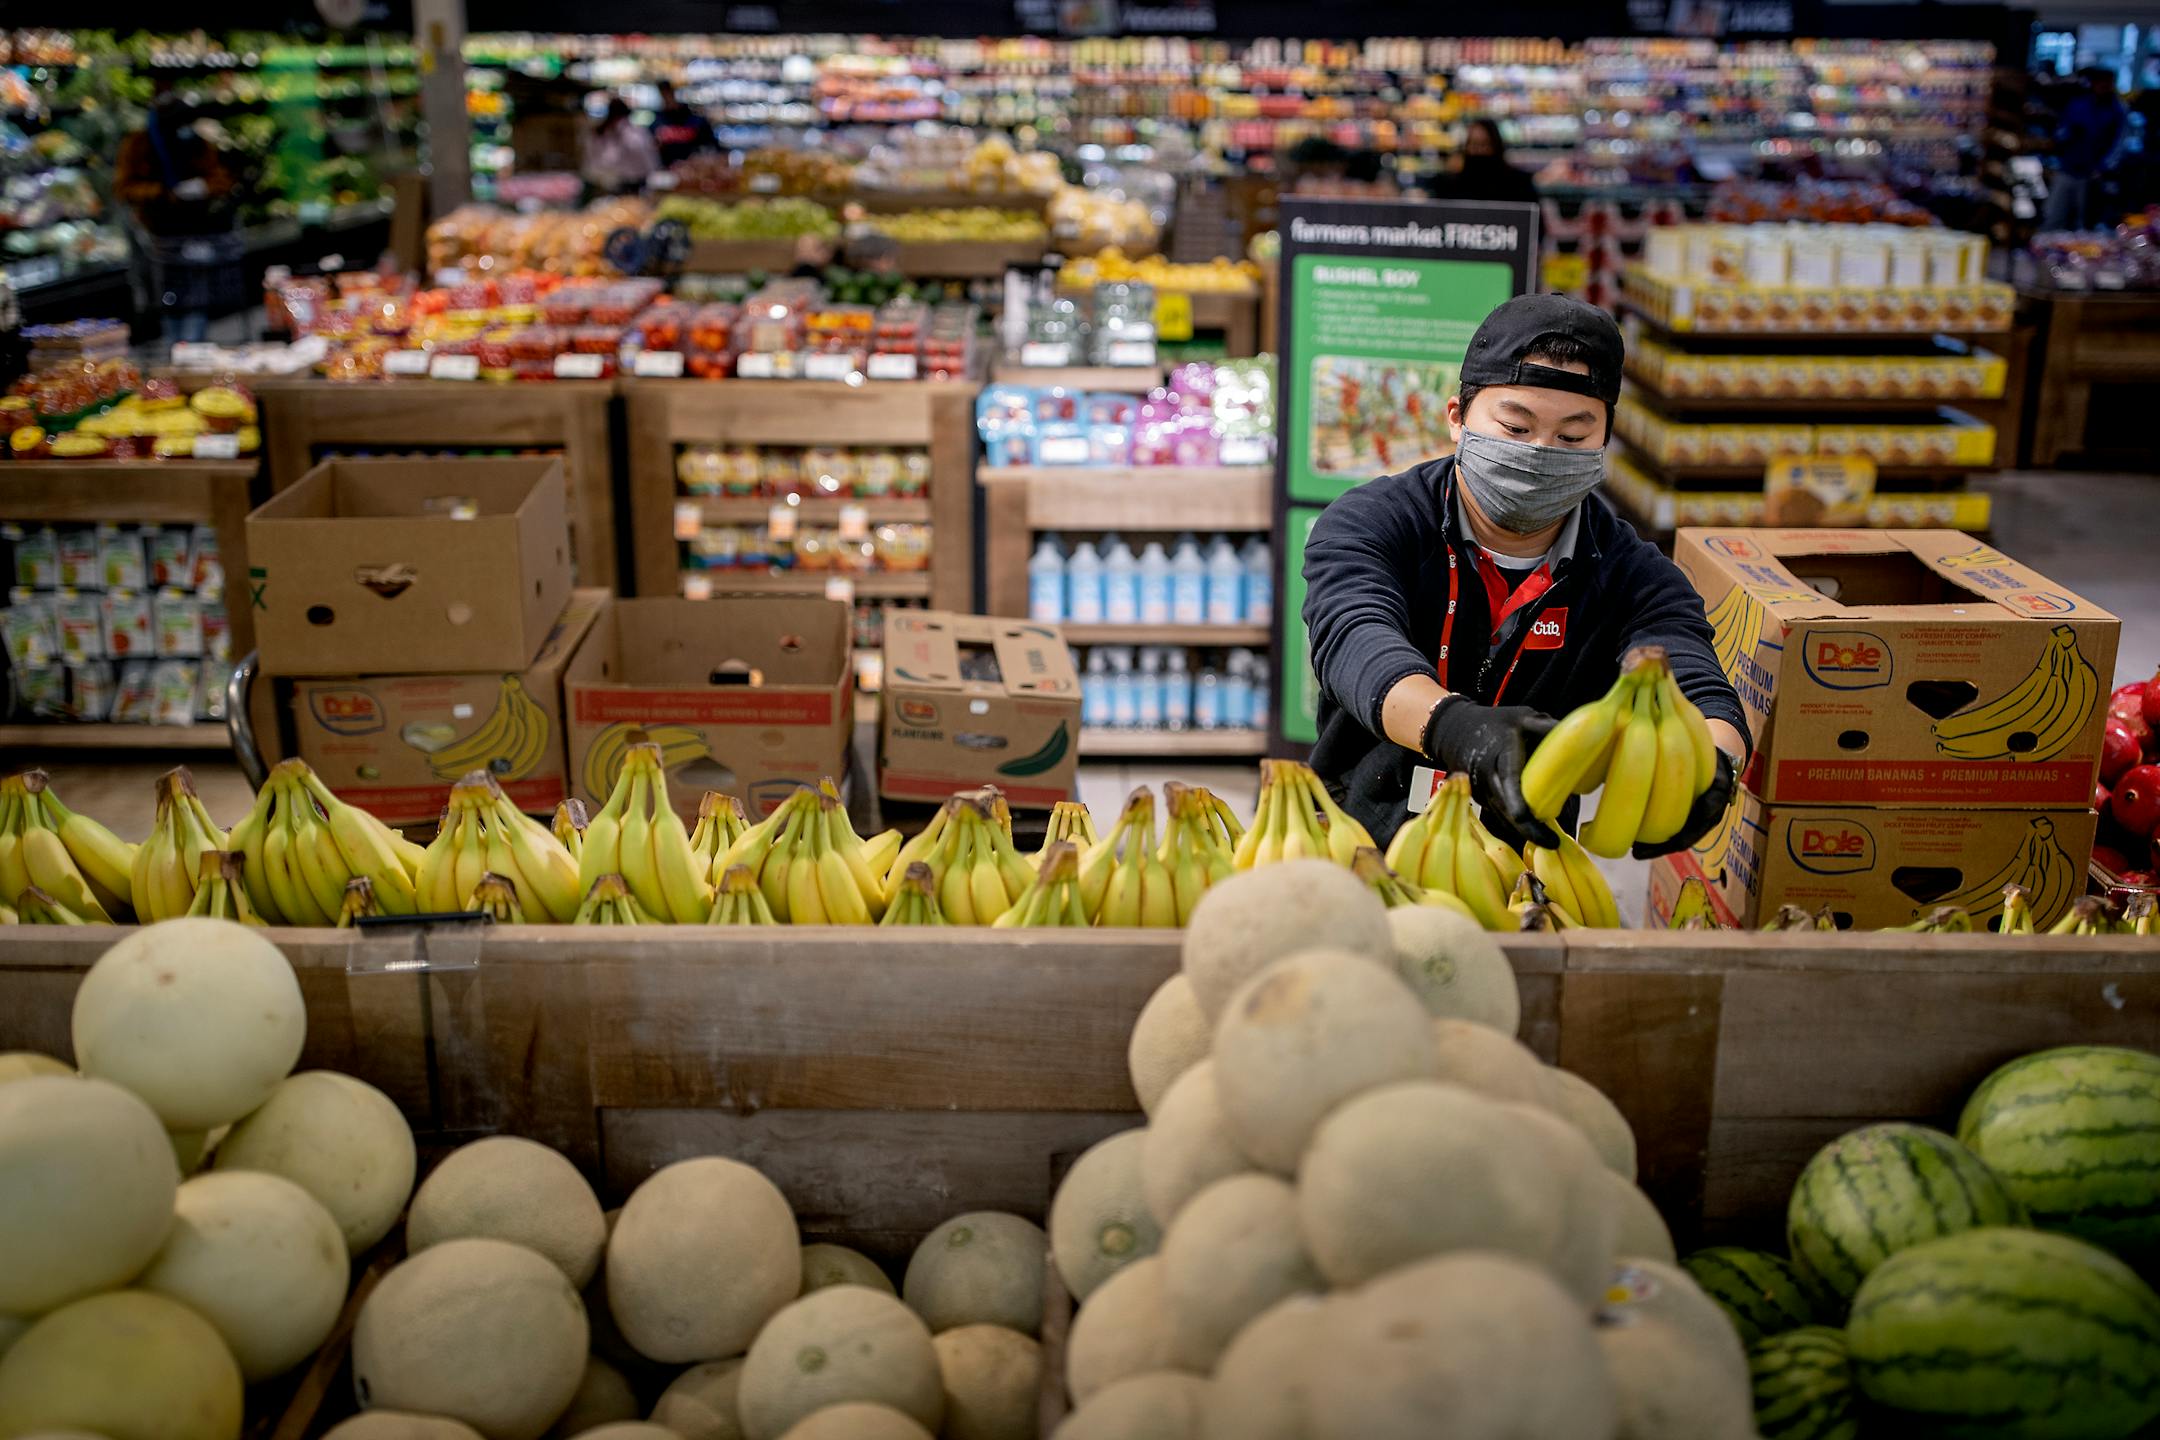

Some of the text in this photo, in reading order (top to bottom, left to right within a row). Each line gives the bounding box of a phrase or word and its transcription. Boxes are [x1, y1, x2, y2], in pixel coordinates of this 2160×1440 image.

[1291, 216, 1517, 251] farmers market FRESH
[1312, 266, 1421, 288] BUSHEL BOY
[1533, 620, 1559, 635] Cub
[1818, 642, 1881, 667] Dole
[1737, 651, 1773, 692] PREMIUM
[323, 696, 373, 714] Dole
[1734, 673, 1772, 716] BANANAS
[892, 728, 944, 741] PLANTAINS
[1808, 768, 2058, 782] PREMIUM BANANAS PREMIUM BANANAS
[1731, 826, 1760, 872] PREMIUM
[1802, 830, 1864, 853] Dole
[1727, 848, 1757, 896] BANANAS
